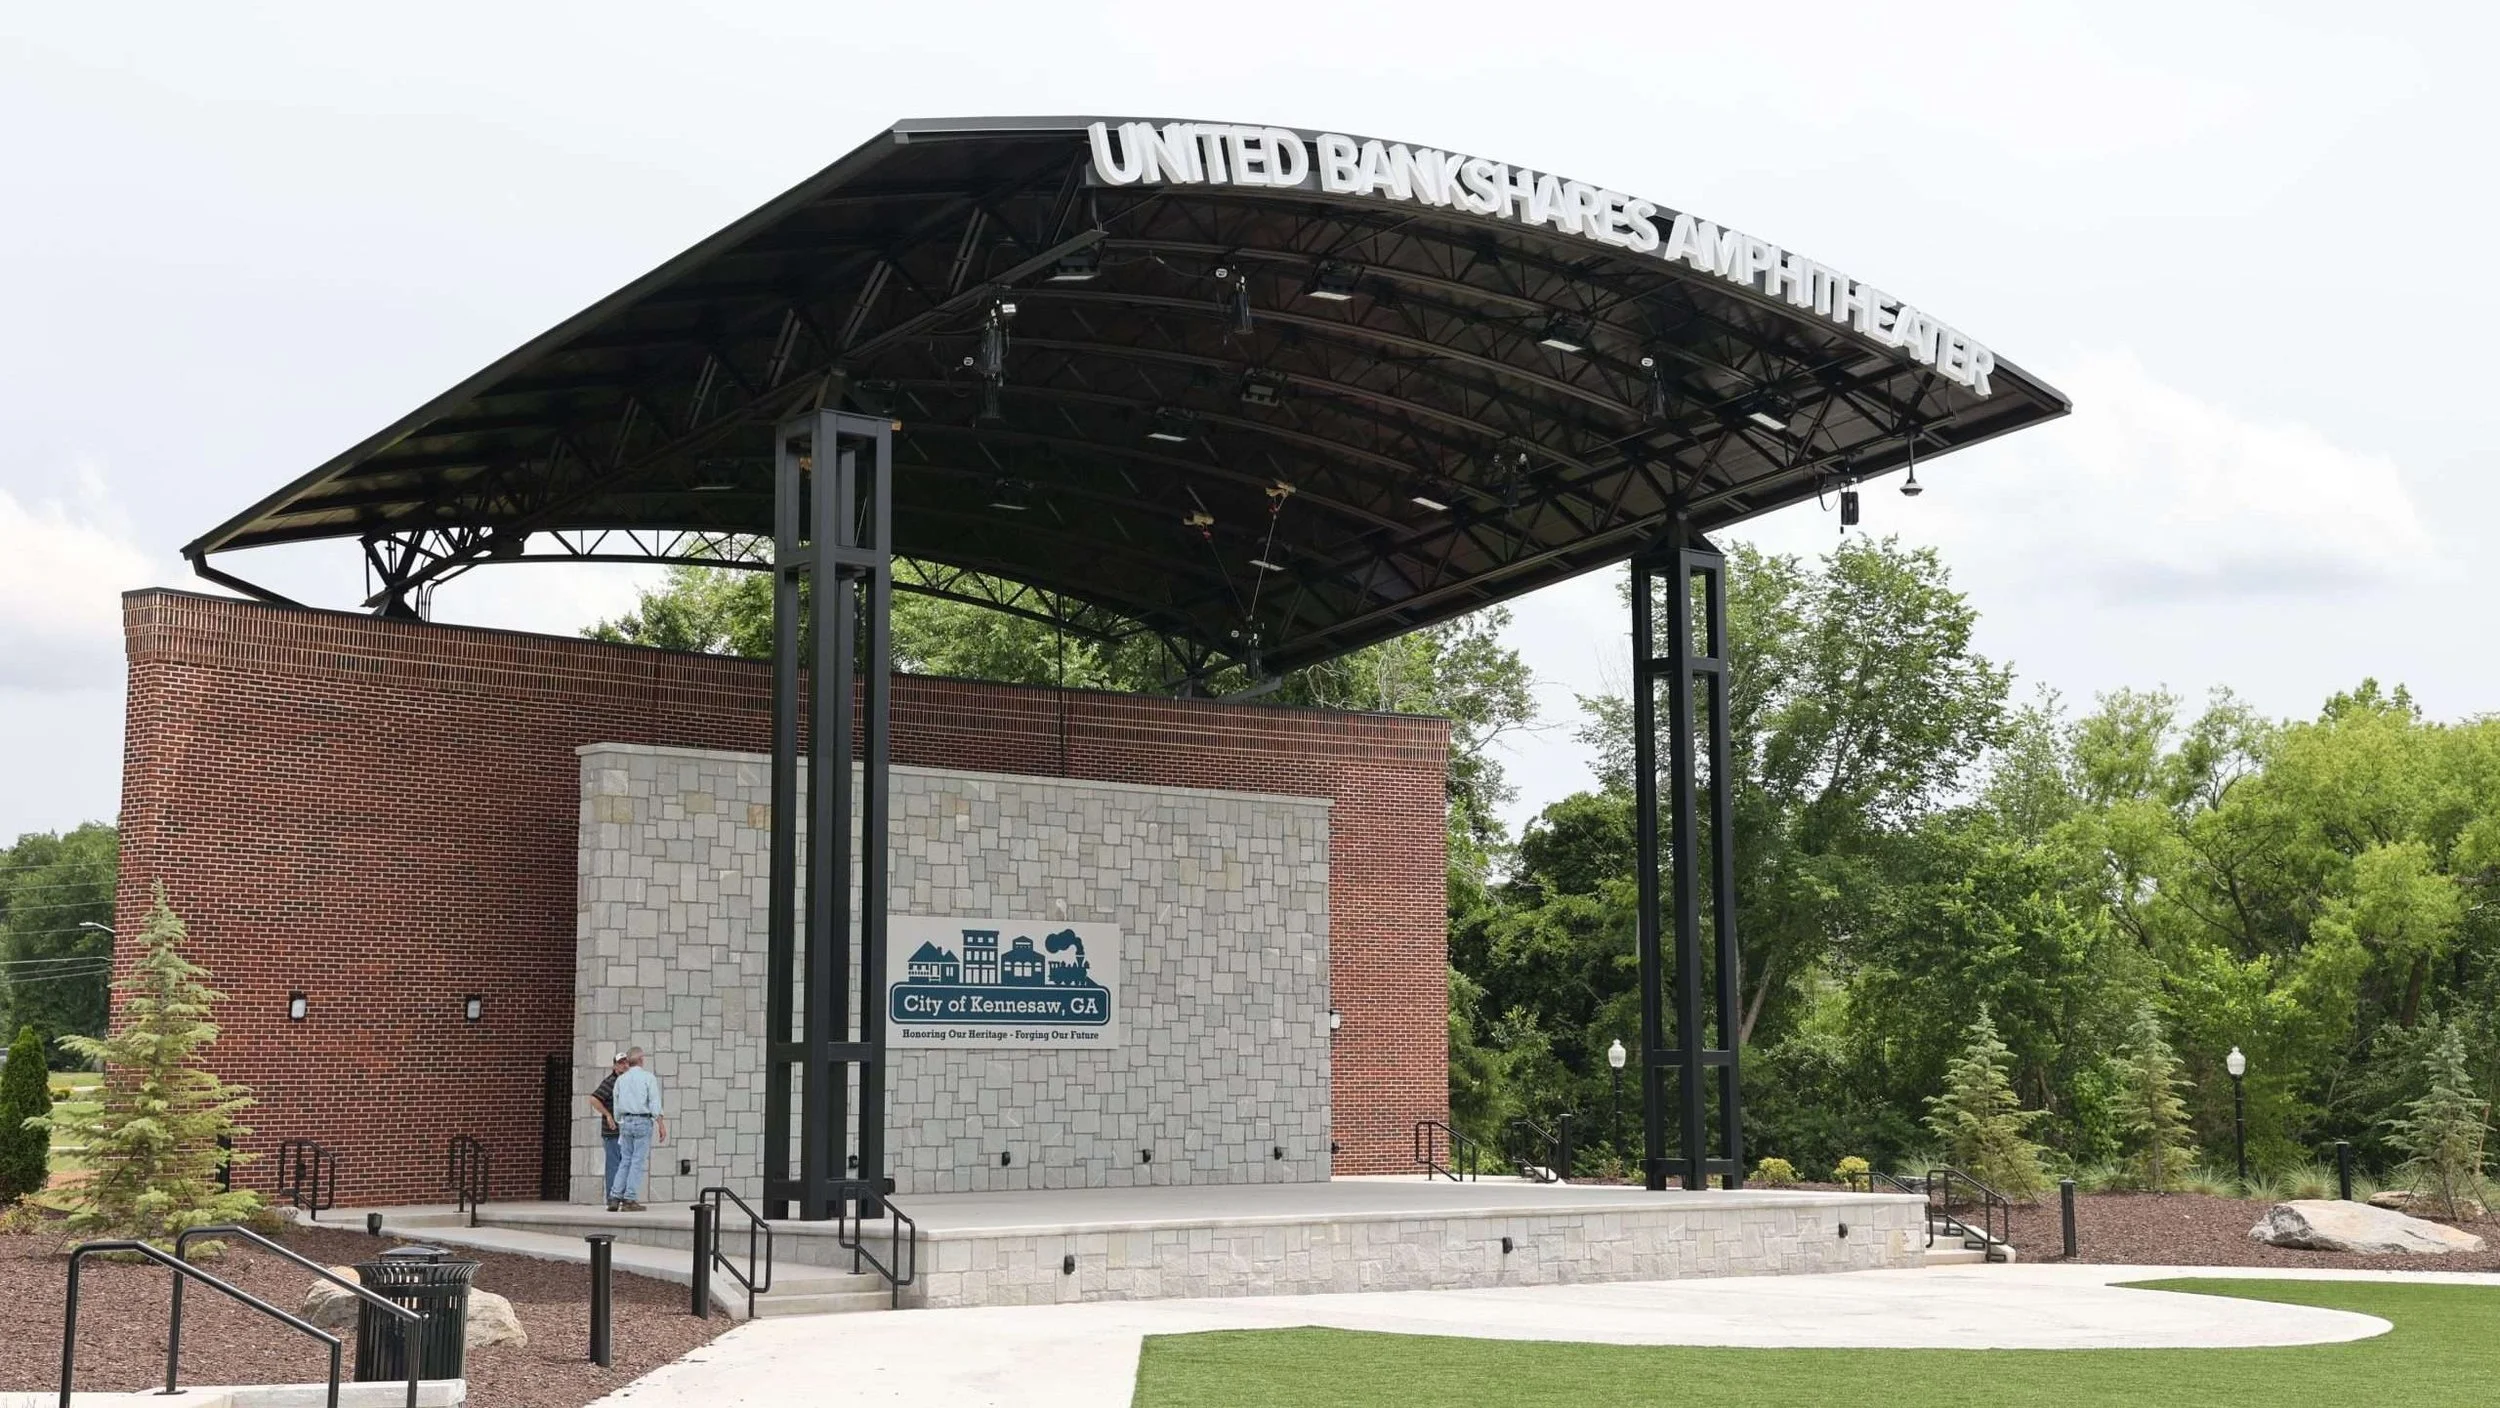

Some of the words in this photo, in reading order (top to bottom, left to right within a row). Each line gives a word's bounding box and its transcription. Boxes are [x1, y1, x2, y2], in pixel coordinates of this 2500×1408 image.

[1087, 121, 1309, 187] UNITED
[1316, 133, 1660, 252] BANKSHARES
[1663, 213, 1995, 397] AMPHITHEATER
[903, 994, 943, 1016] City
[948, 994, 967, 1013] of
[970, 996, 1066, 1016] Kennesaw,
[1070, 997, 1099, 1015] GA
[902, 1029, 946, 1040] Honoring
[948, 1029, 967, 1039] Our
[968, 1029, 1008, 1041] Heritage
[1015, 1030, 1049, 1041] Forging
[1051, 1030, 1068, 1040] Our
[1070, 1030, 1099, 1040] Future
